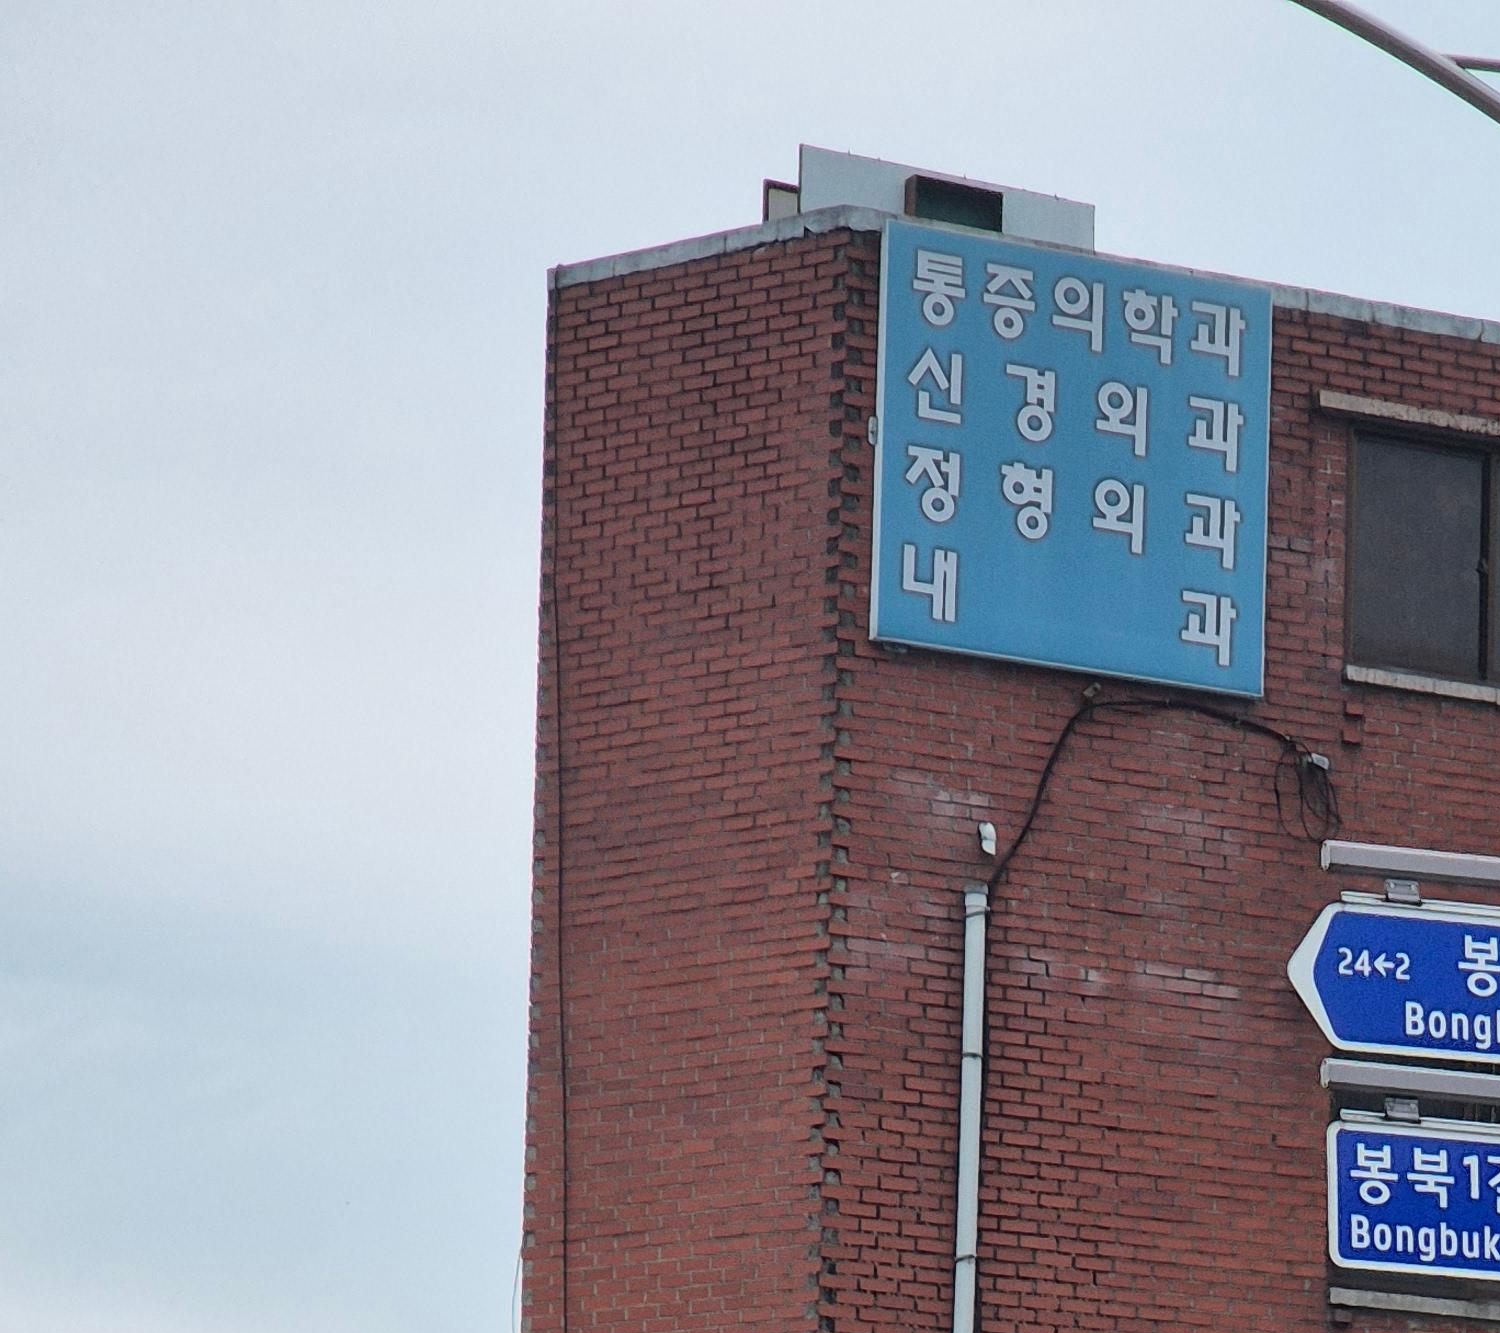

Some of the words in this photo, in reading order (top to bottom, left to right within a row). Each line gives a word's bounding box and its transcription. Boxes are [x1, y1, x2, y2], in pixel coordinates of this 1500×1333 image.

[912, 249, 1246, 378] 통증의학과
[907, 347, 1245, 474] 신경외과
[904, 444, 1242, 571] 정형외과
[1350, 1213, 1500, 1262] Bongbuk
